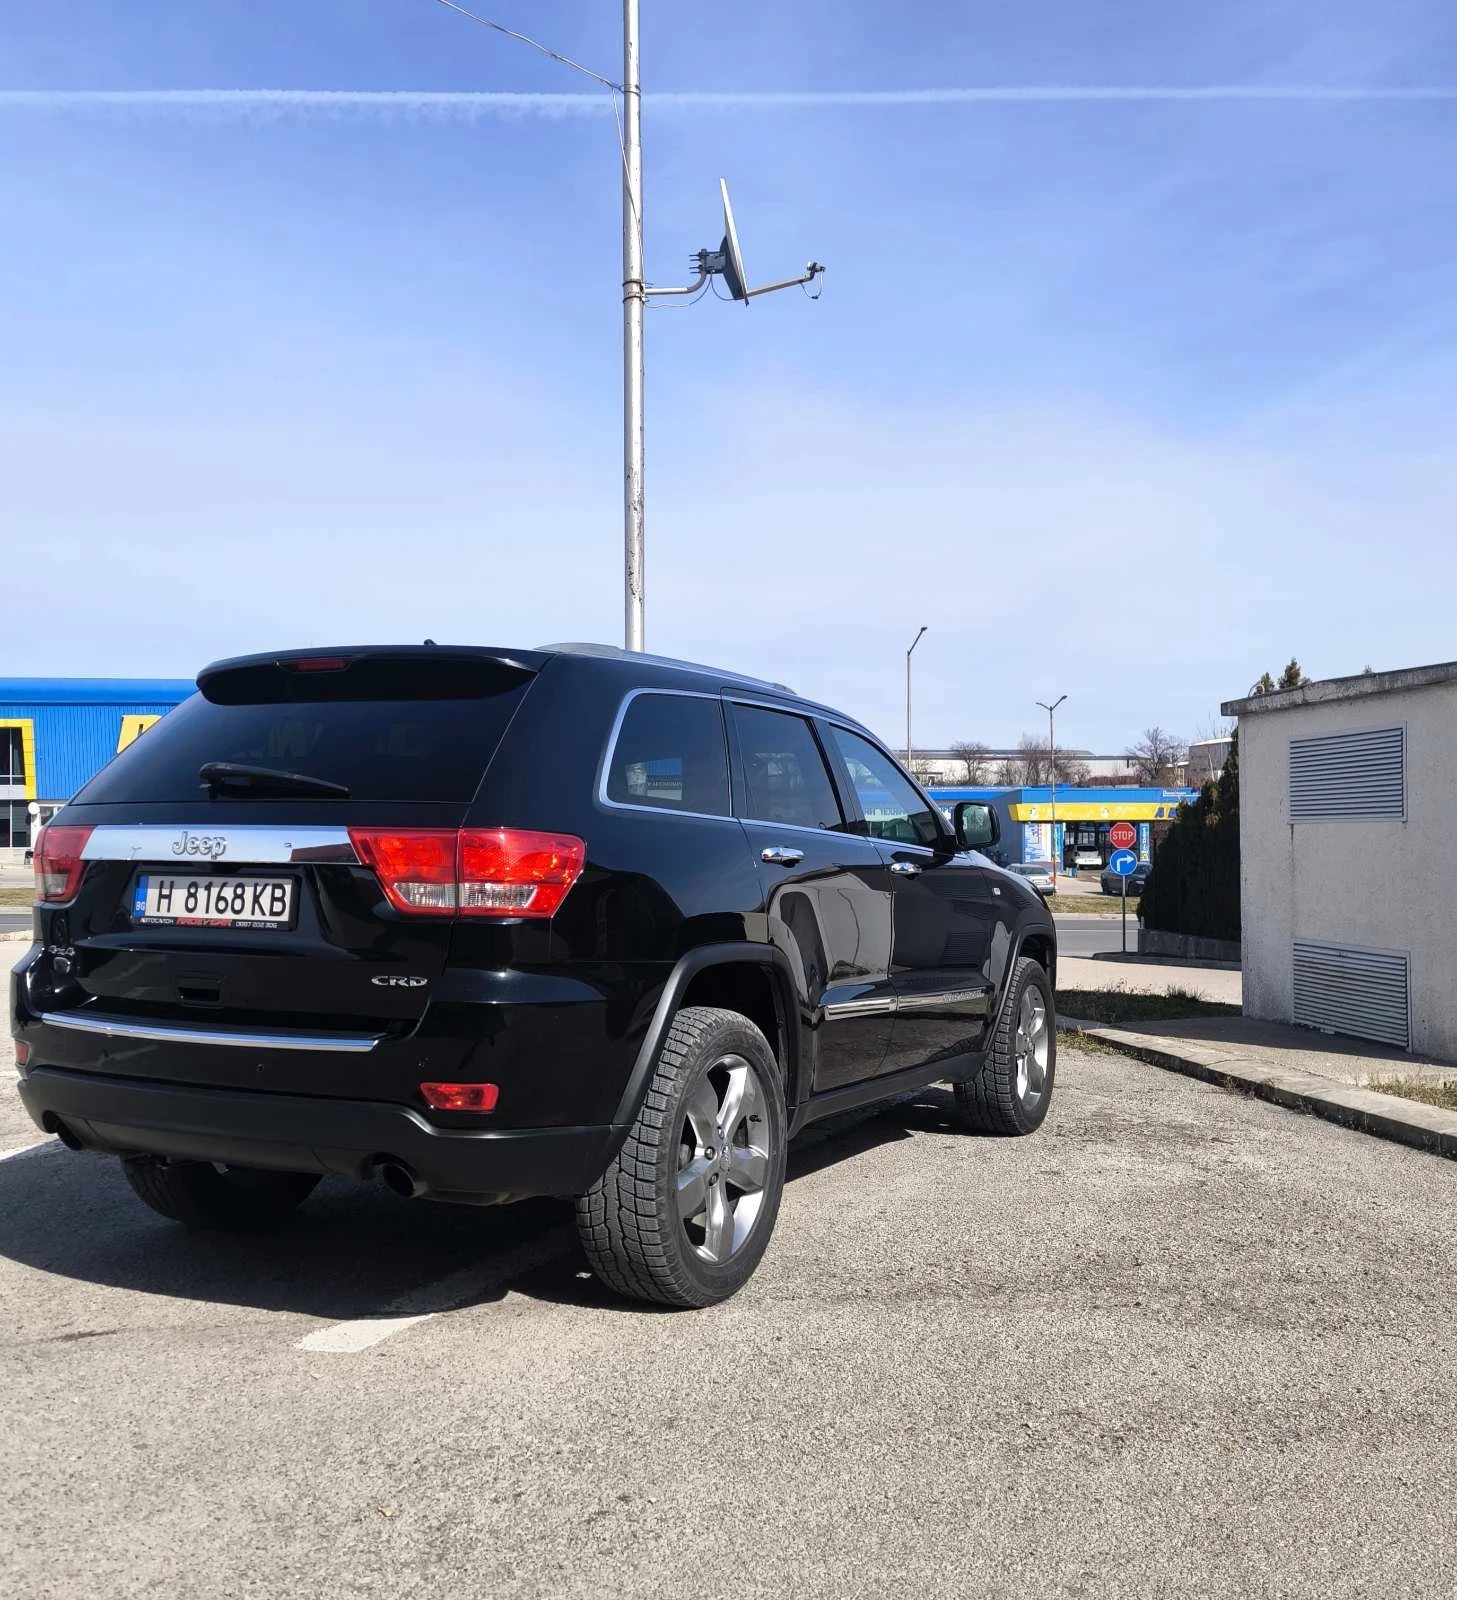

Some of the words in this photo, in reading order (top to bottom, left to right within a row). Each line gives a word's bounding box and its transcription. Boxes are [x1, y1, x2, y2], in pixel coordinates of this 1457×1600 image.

[1112, 831, 1134, 841] STOP
[172, 831, 227, 860] Jeep
[156, 880, 175, 913] H
[184, 880, 246, 915] 8168
[251, 882, 287, 917] KB
[135, 901, 146, 911] BG
[371, 975, 428, 987] CRD
